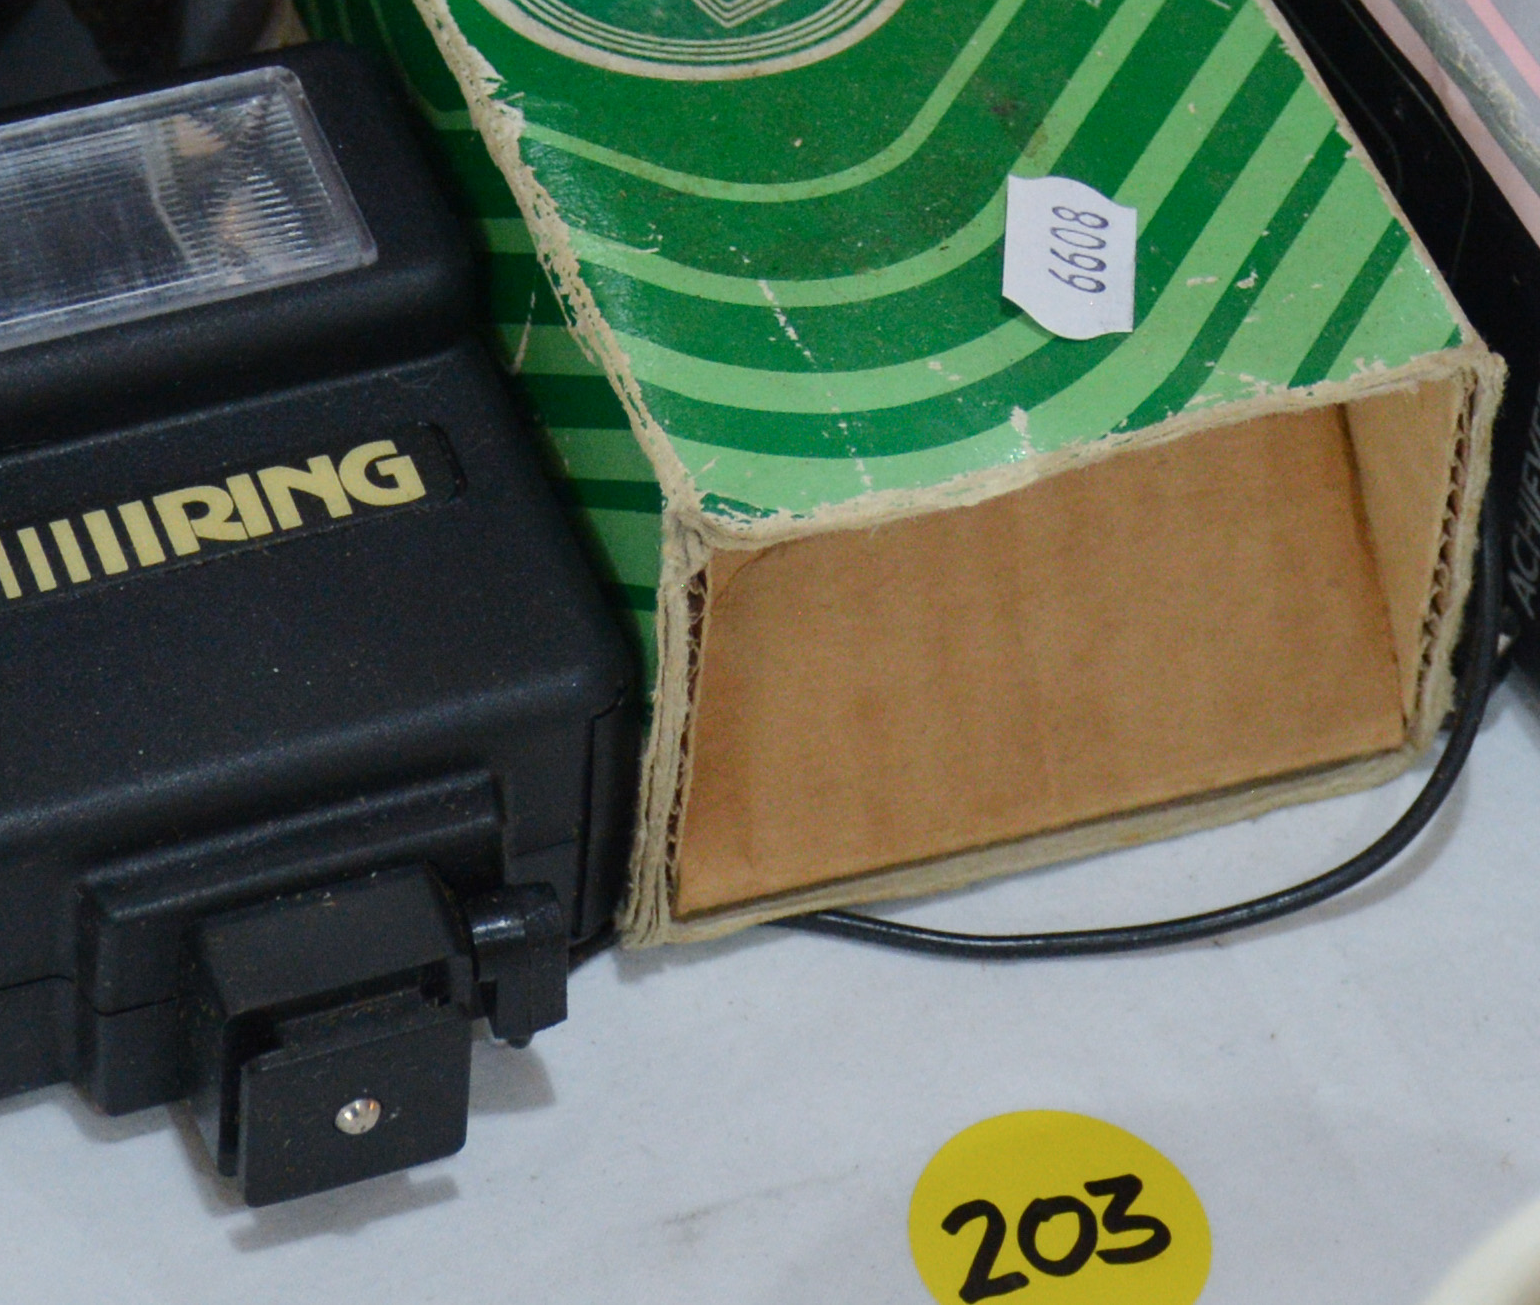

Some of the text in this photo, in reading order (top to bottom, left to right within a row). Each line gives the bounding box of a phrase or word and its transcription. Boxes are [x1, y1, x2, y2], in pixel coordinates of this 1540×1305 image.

[1048, 206, 1110, 296] 6608
[153, 439, 426, 556] RING
[941, 1174, 1172, 1305] 203
